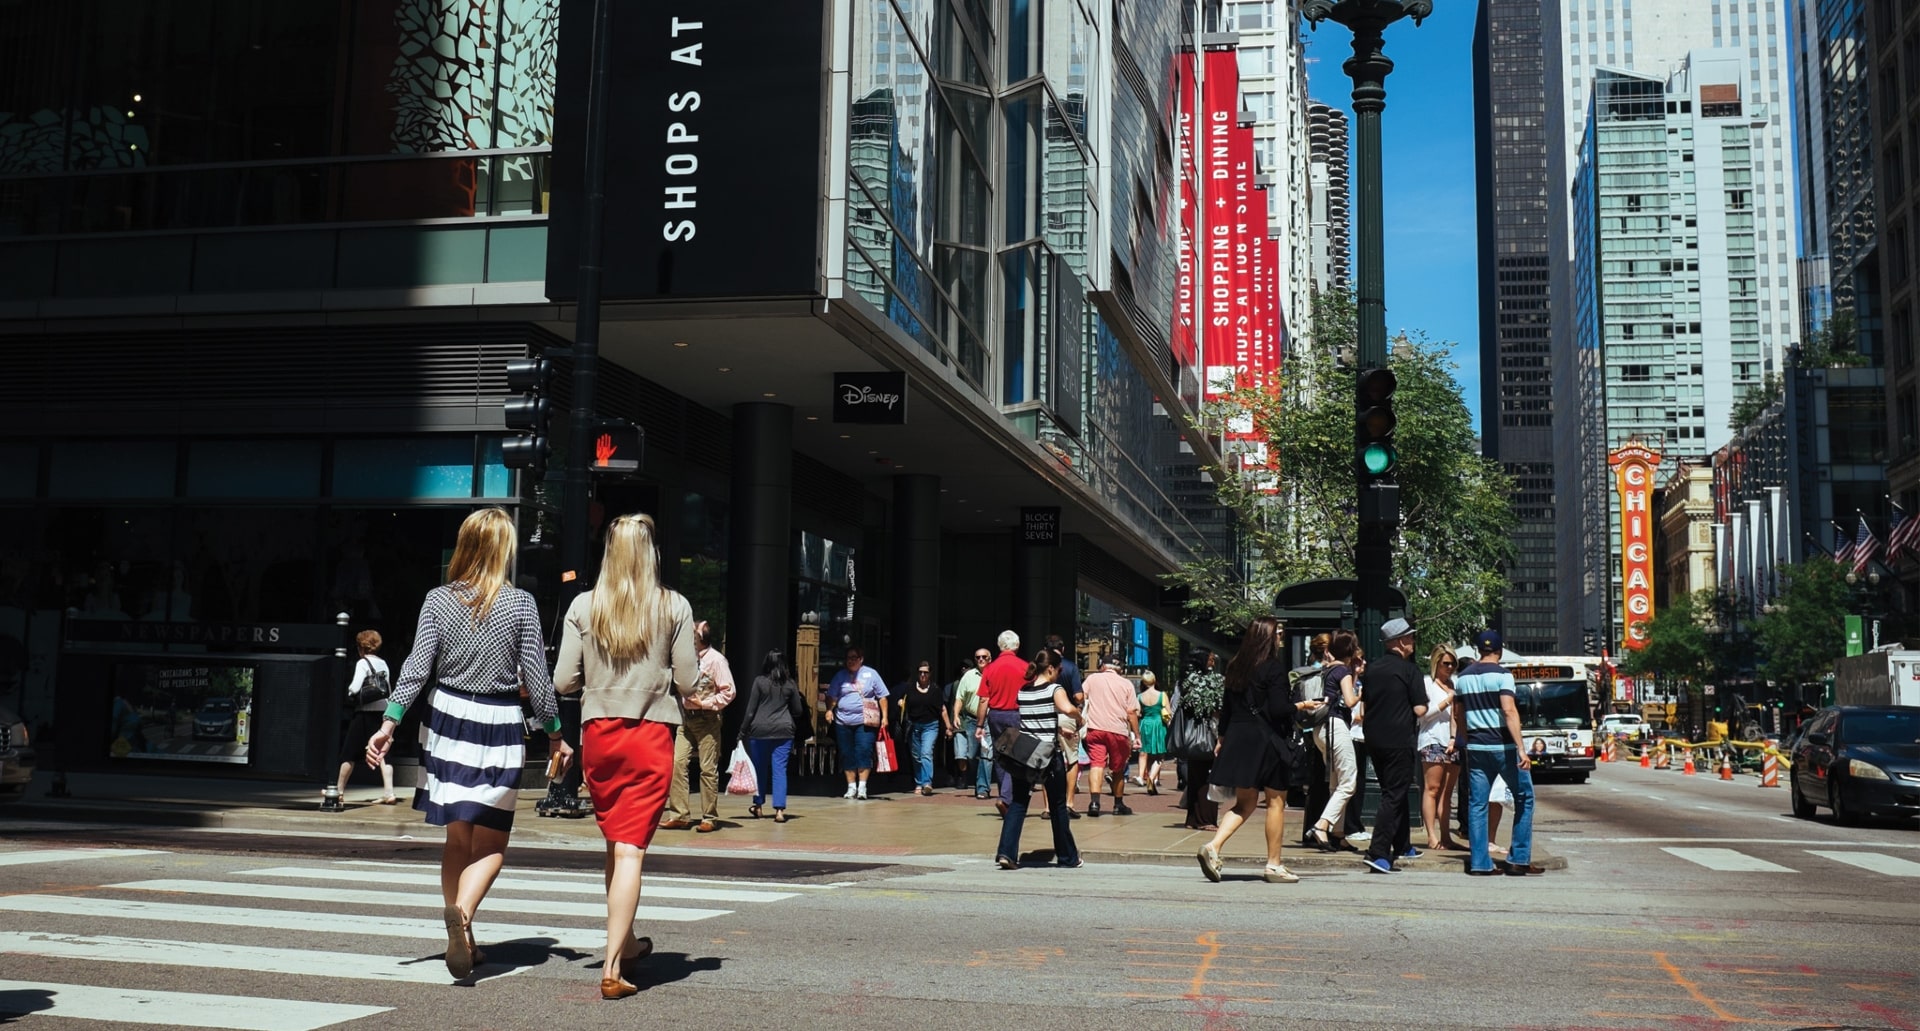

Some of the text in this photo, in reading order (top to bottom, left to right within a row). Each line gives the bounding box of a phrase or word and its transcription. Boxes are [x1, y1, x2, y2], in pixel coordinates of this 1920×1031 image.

[663, 16, 704, 242] SHOPS AT
[1212, 111, 1229, 179] DINING
[1213, 225, 1230, 326] SHOPPING
[1616, 448, 1644, 460] CHASE
[1024, 512, 1056, 522] BLOCK
[1024, 522, 1056, 531] THIRTY
[1024, 531, 1054, 540] SEVEN
[1625, 464, 1650, 641] CHICAGO
[121, 624, 281, 643] NEWSPAPERS
